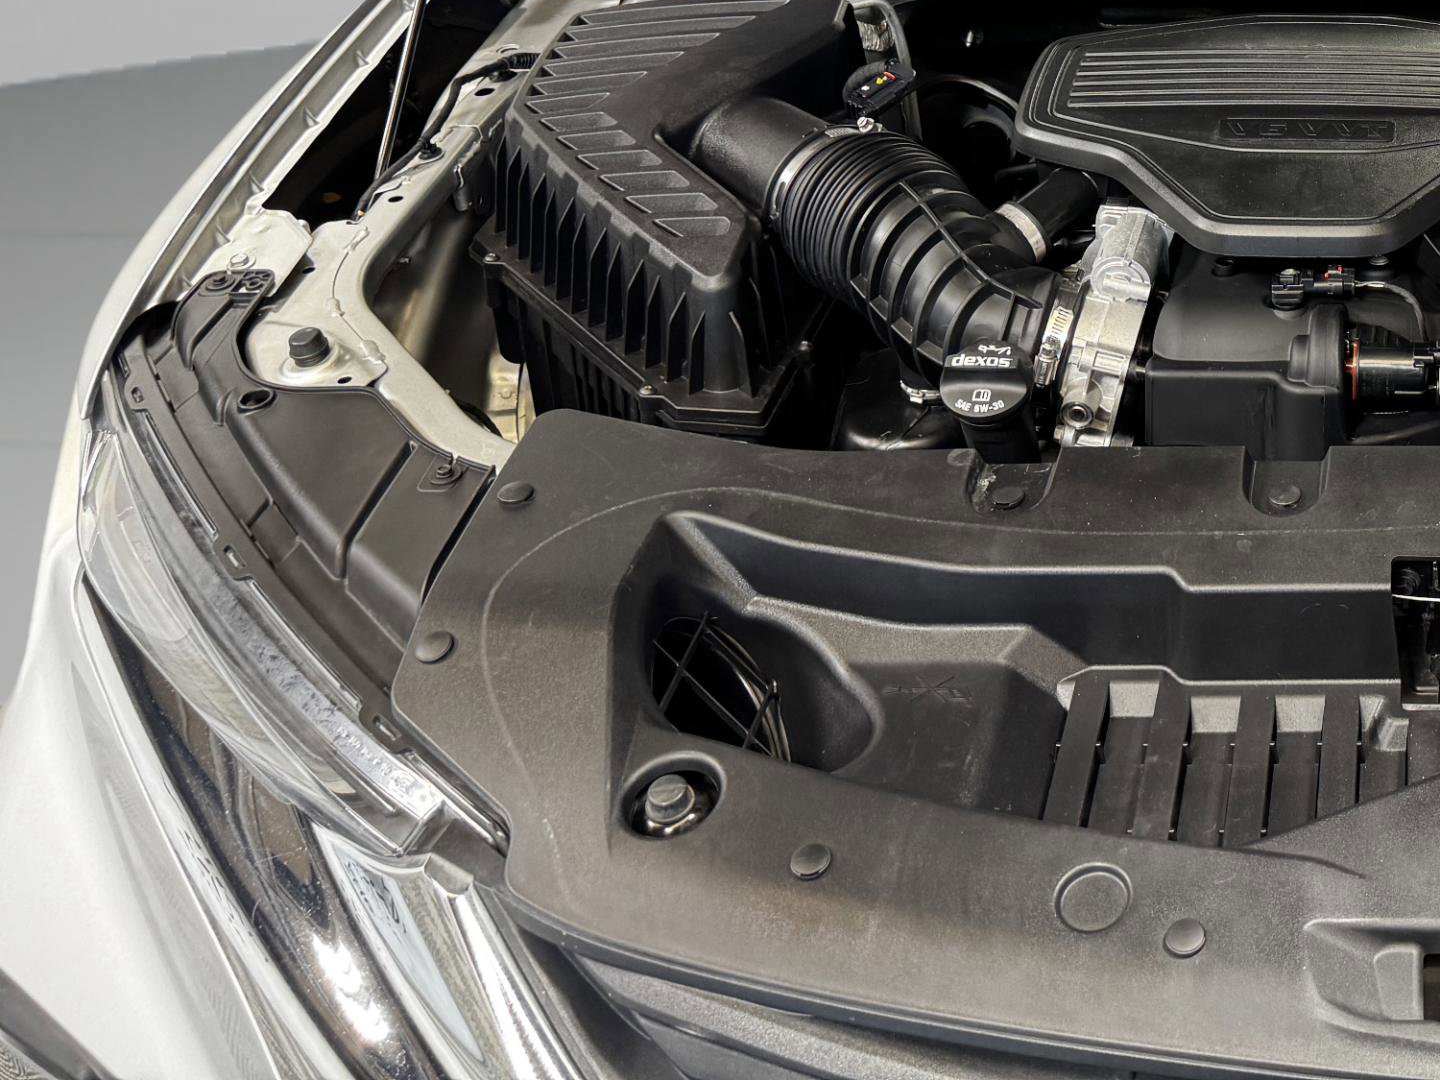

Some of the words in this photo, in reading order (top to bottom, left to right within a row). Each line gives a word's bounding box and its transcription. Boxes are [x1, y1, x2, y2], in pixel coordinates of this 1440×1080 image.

[951, 354, 1013, 368] dexos
[954, 399, 972, 412] SAE
[973, 399, 1005, 413] 5W-30
